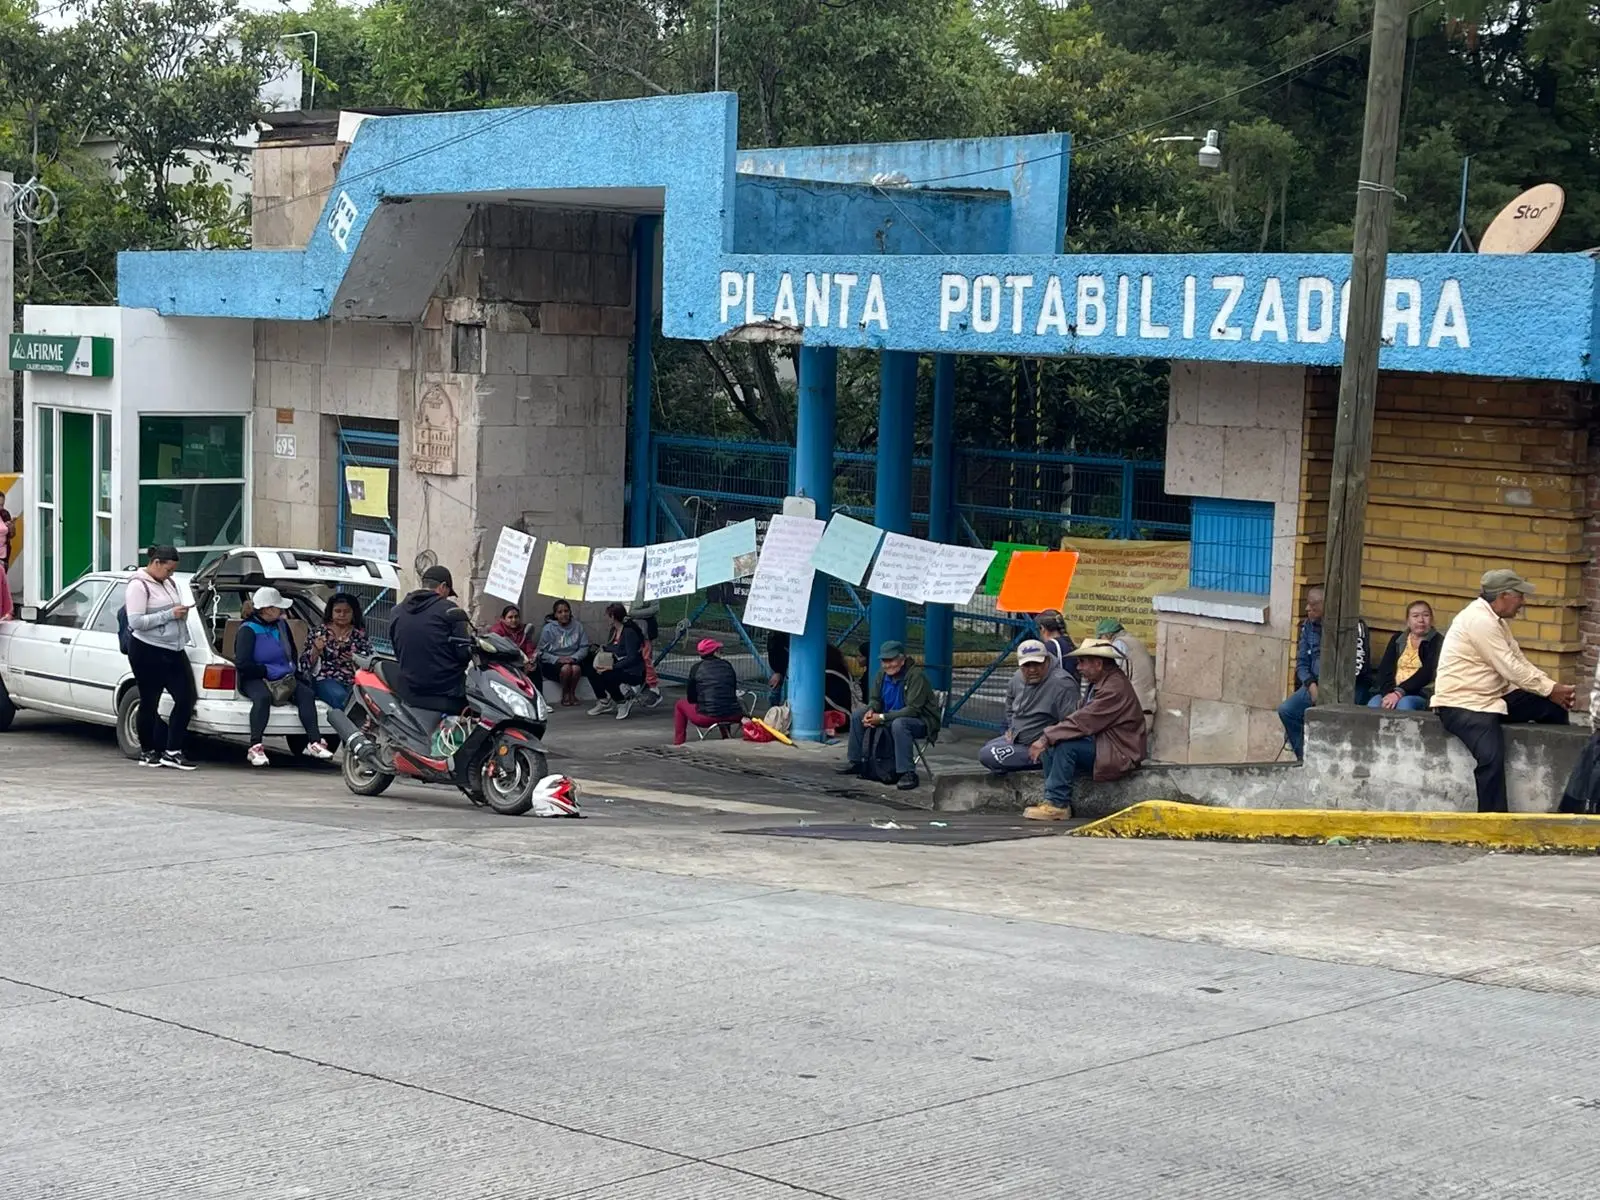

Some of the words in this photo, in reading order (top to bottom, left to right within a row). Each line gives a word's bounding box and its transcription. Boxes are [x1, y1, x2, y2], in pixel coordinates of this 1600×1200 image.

[719, 270, 889, 331] PLANTA
[939, 272, 1471, 348] POTABILIZADRA
[27, 343, 64, 361] AFIRME
[276, 437, 294, 456] 695
